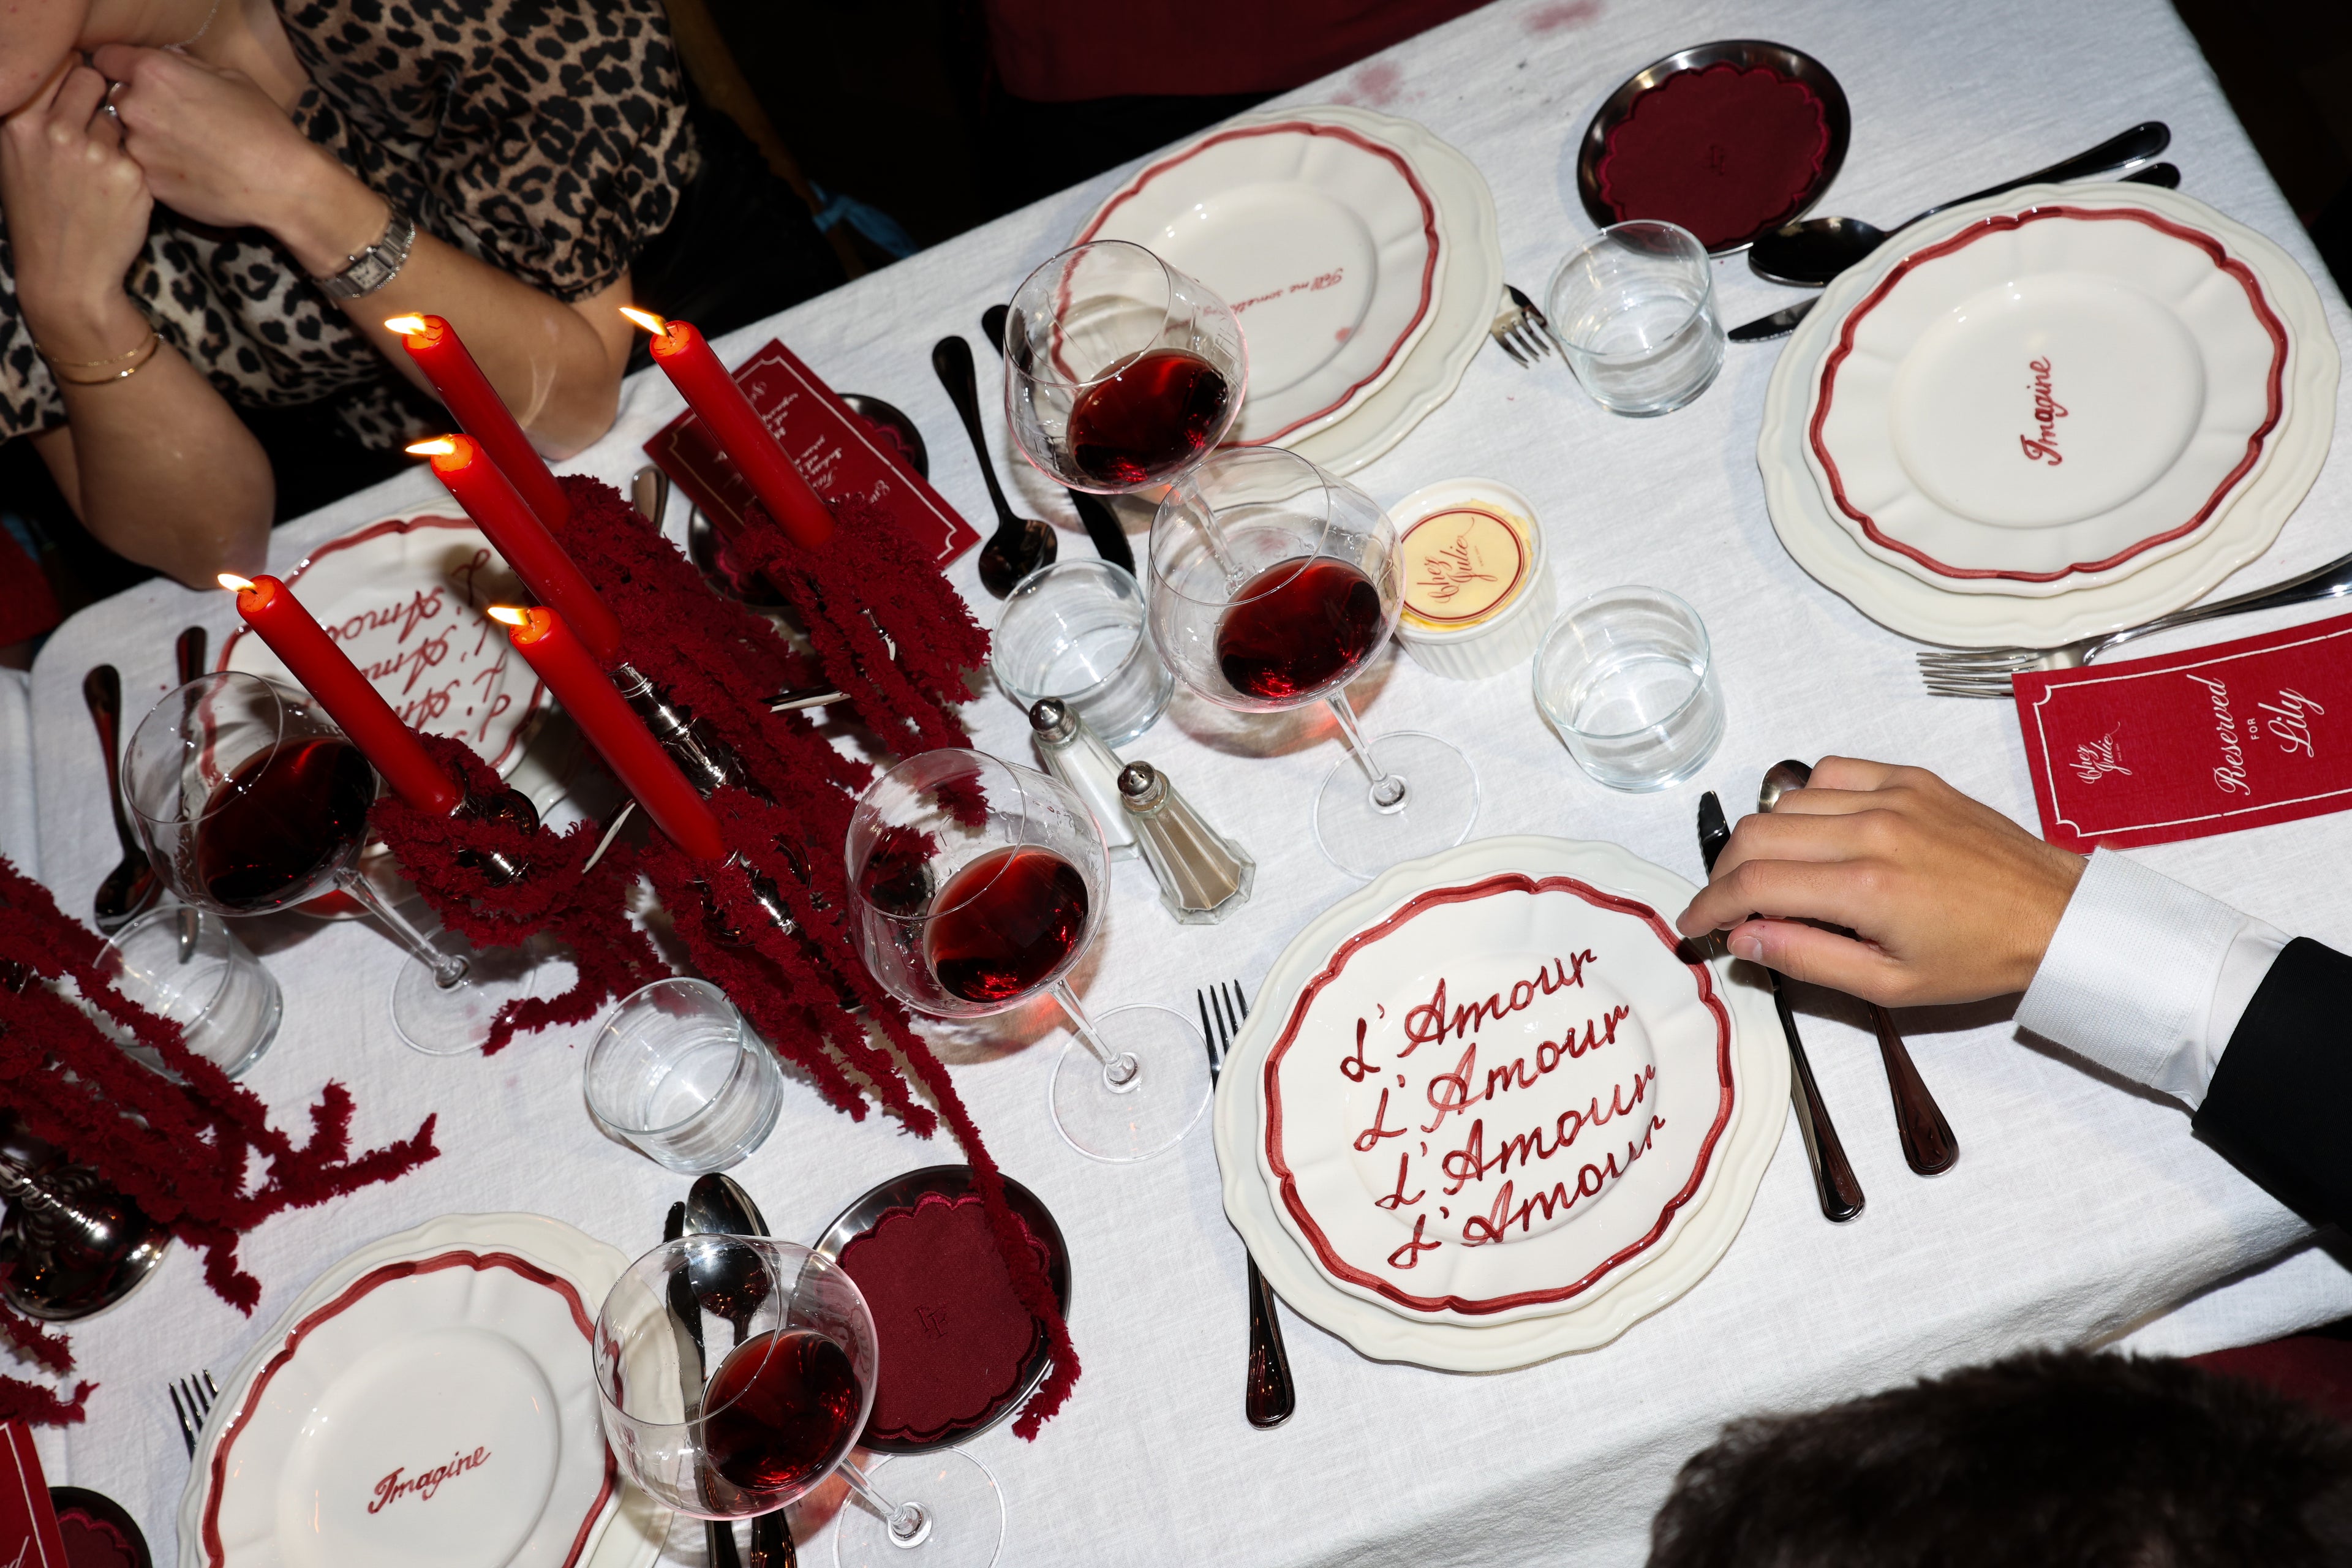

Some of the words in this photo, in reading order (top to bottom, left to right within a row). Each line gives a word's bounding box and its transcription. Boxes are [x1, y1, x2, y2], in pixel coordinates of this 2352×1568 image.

[2021, 356, 2069, 466] Imagine
[1416, 556, 1460, 604] Chez
[1439, 516, 1499, 583] Julie
[329, 548, 491, 644] L'Amou
[2068, 744, 2103, 784] Chez
[2089, 721, 2133, 776] Julie
[2186, 674, 2251, 796] Reserved
[2248, 718, 2259, 741] FOR
[2258, 687, 2325, 758] Lily
[1340, 948, 1597, 1082] L'Amour
[1353, 1005, 1630, 1152] L'Amour
[1374, 1064, 1656, 1210] L'Amour
[1387, 1114, 1667, 1270] L'Amour
[367, 1446, 491, 1514] Imagine
